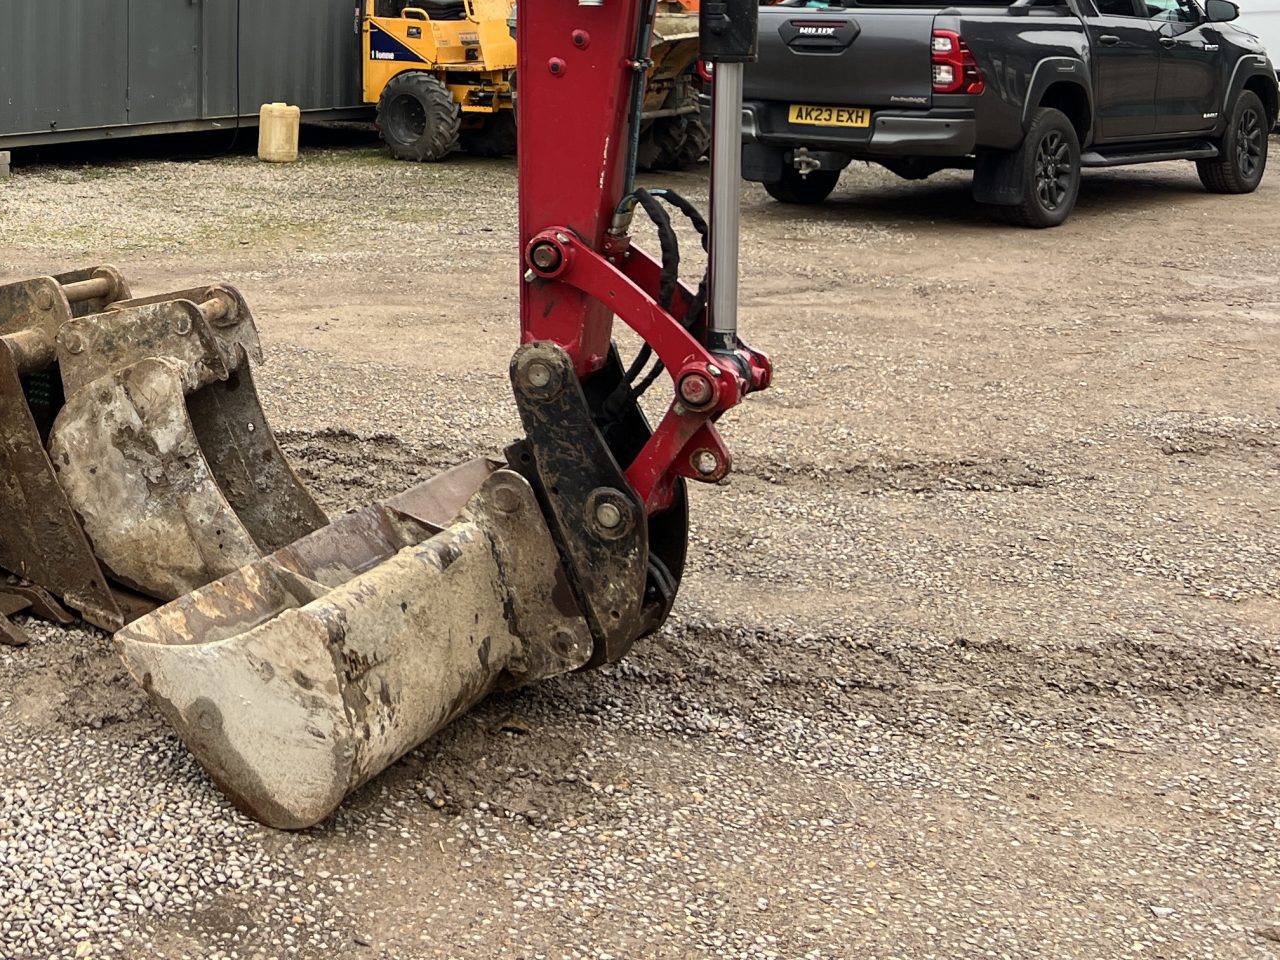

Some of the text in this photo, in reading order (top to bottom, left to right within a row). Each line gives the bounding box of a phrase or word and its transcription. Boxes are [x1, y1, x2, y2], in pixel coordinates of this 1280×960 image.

[799, 27, 835, 36] HILUX
[795, 106, 865, 124] AK23 EXH
